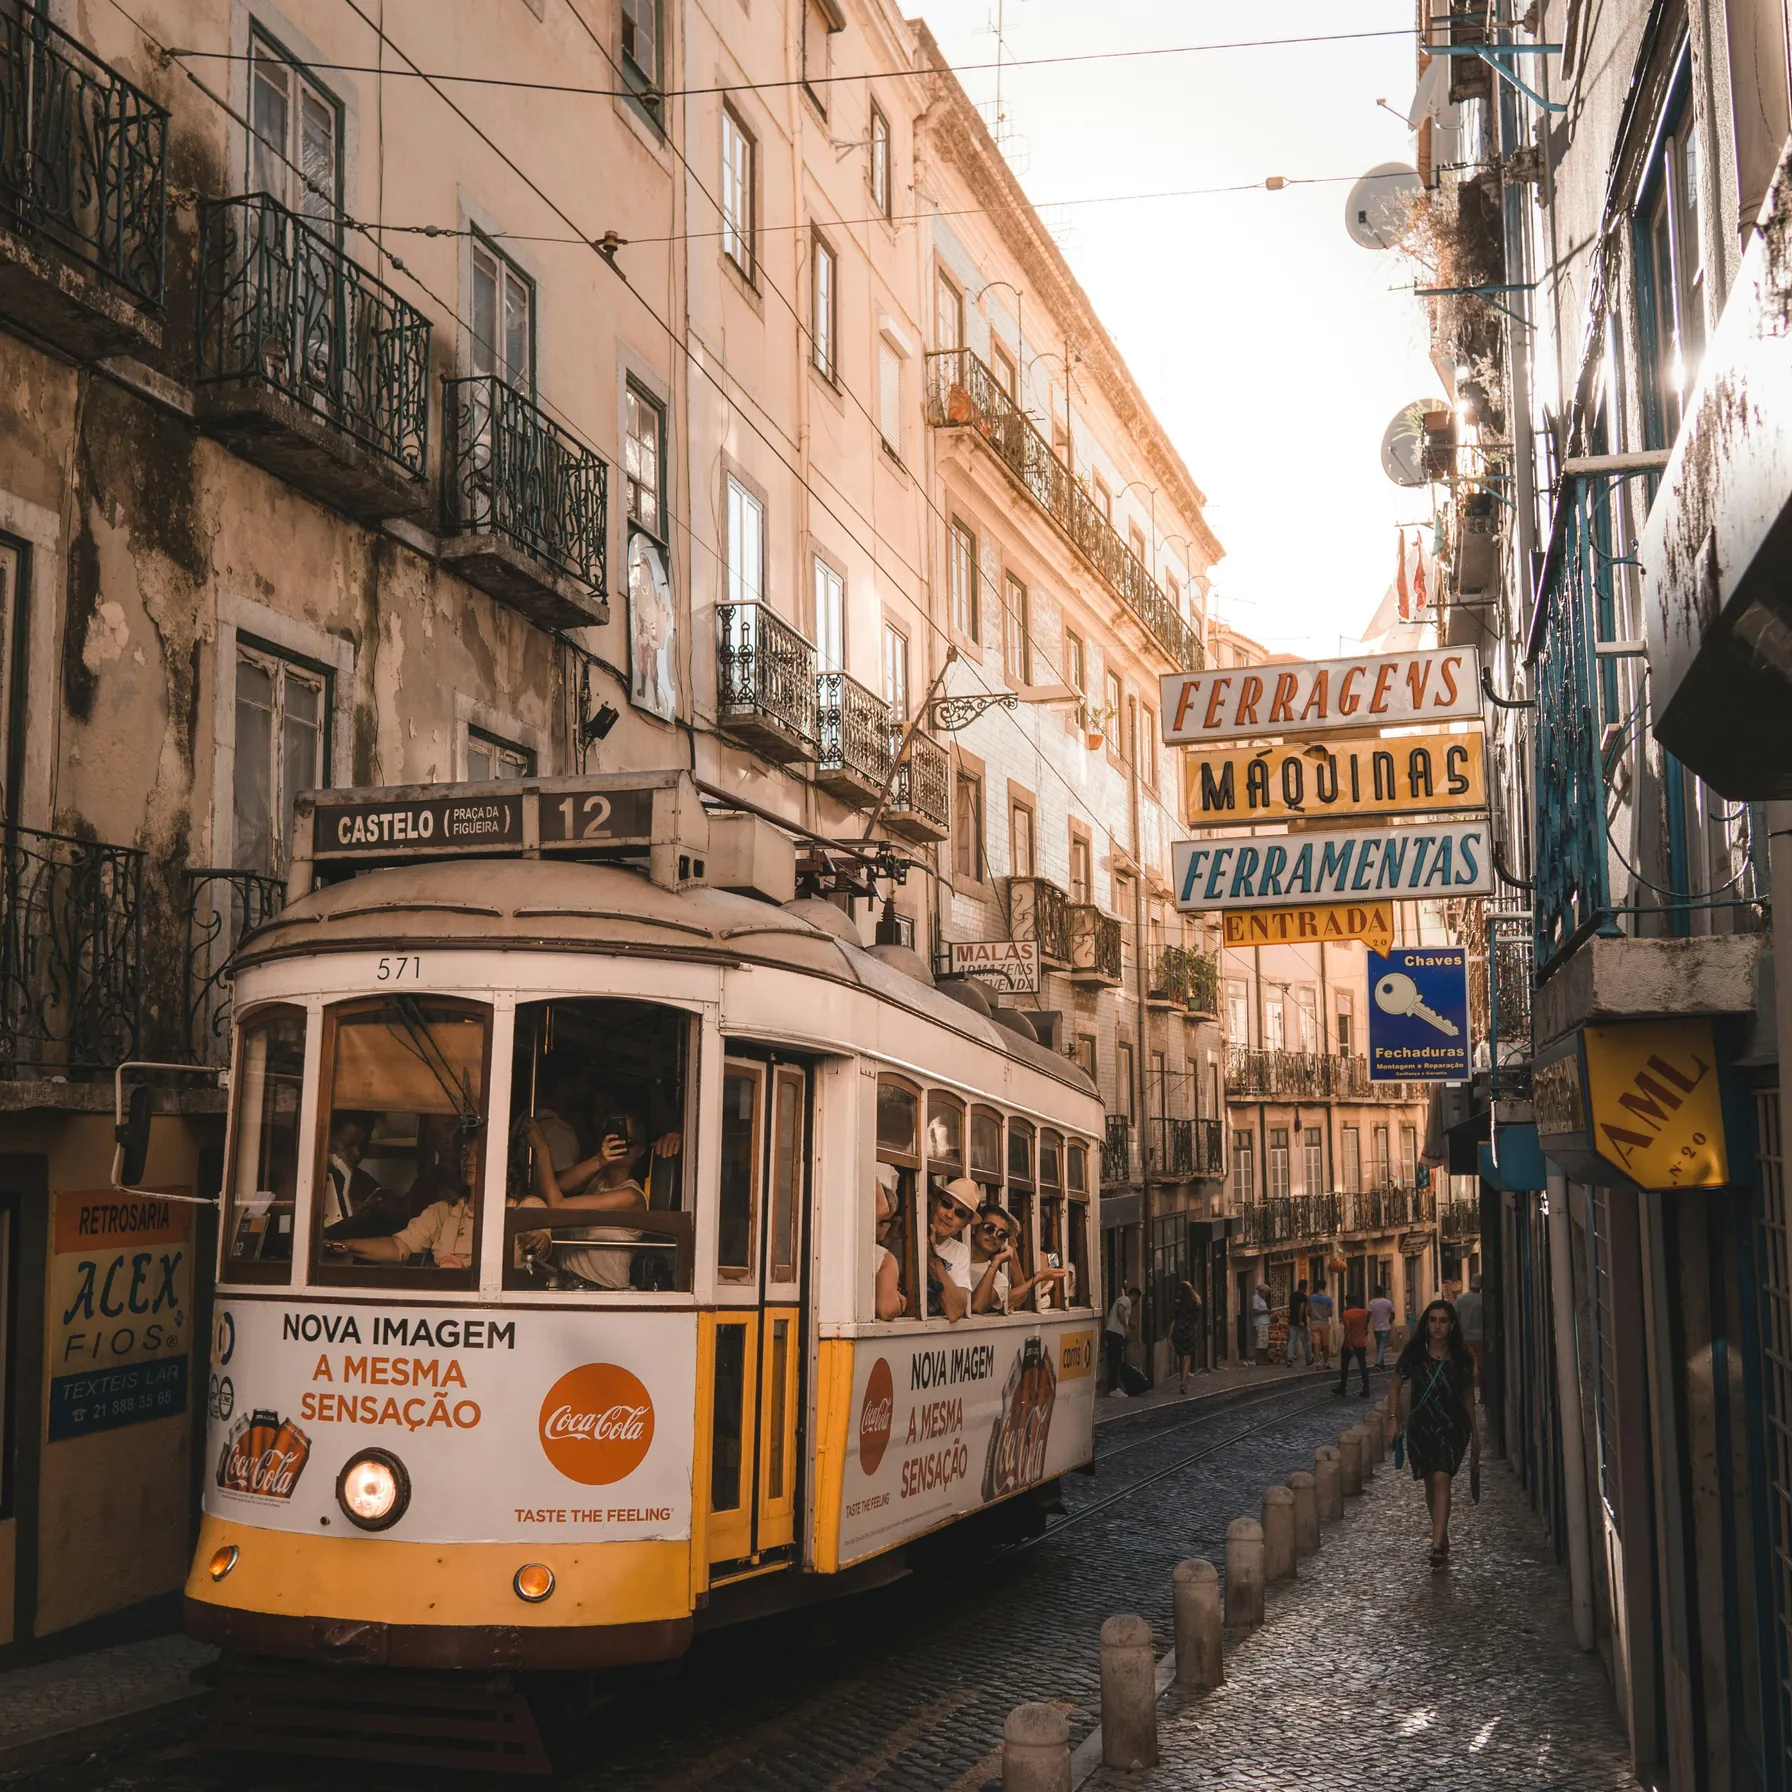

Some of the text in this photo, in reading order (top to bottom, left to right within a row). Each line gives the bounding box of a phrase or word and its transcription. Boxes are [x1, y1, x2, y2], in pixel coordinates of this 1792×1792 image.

[1173, 657, 1463, 731] FERRAGENS
[1201, 745, 1469, 812] MÁQUINAS
[338, 809, 434, 844] CASTELO
[558, 795, 612, 840] 12
[1181, 832, 1483, 902] FERRAMENTAS
[1226, 907, 1388, 943] ENTRADA
[1372, 938, 1388, 947] 20
[377, 957, 421, 980] 571
[956, 944, 1033, 962] MALAS
[1404, 955, 1462, 966] Chaves
[1375, 1046, 1464, 1058] Fechaduras
[1424, 1062, 1464, 1070] Reparação
[1600, 1053, 1710, 1169] AML
[1682, 1132, 1707, 1159] 20
[79, 1203, 170, 1235] RETROSARIA
[283, 1313, 515, 1349] NOVA IMAGEM
[62, 1364, 179, 1400] TEXTEIS LAR
[312, 1354, 467, 1388] A MESMA
[911, 1345, 994, 1390] NOVA IMAGEM
[93, 1389, 172, 1419] 21 888 35 65
[301, 1391, 481, 1432] SENSAÇÃO
[905, 1397, 963, 1445] A MESMA
[545, 1404, 650, 1441] Coca-Cola
[900, 1437, 968, 1499] SENSAÇÃO
[515, 1507, 671, 1523] TASTE THE FEELING
[845, 1493, 890, 1518] TASTE THE FEELING
